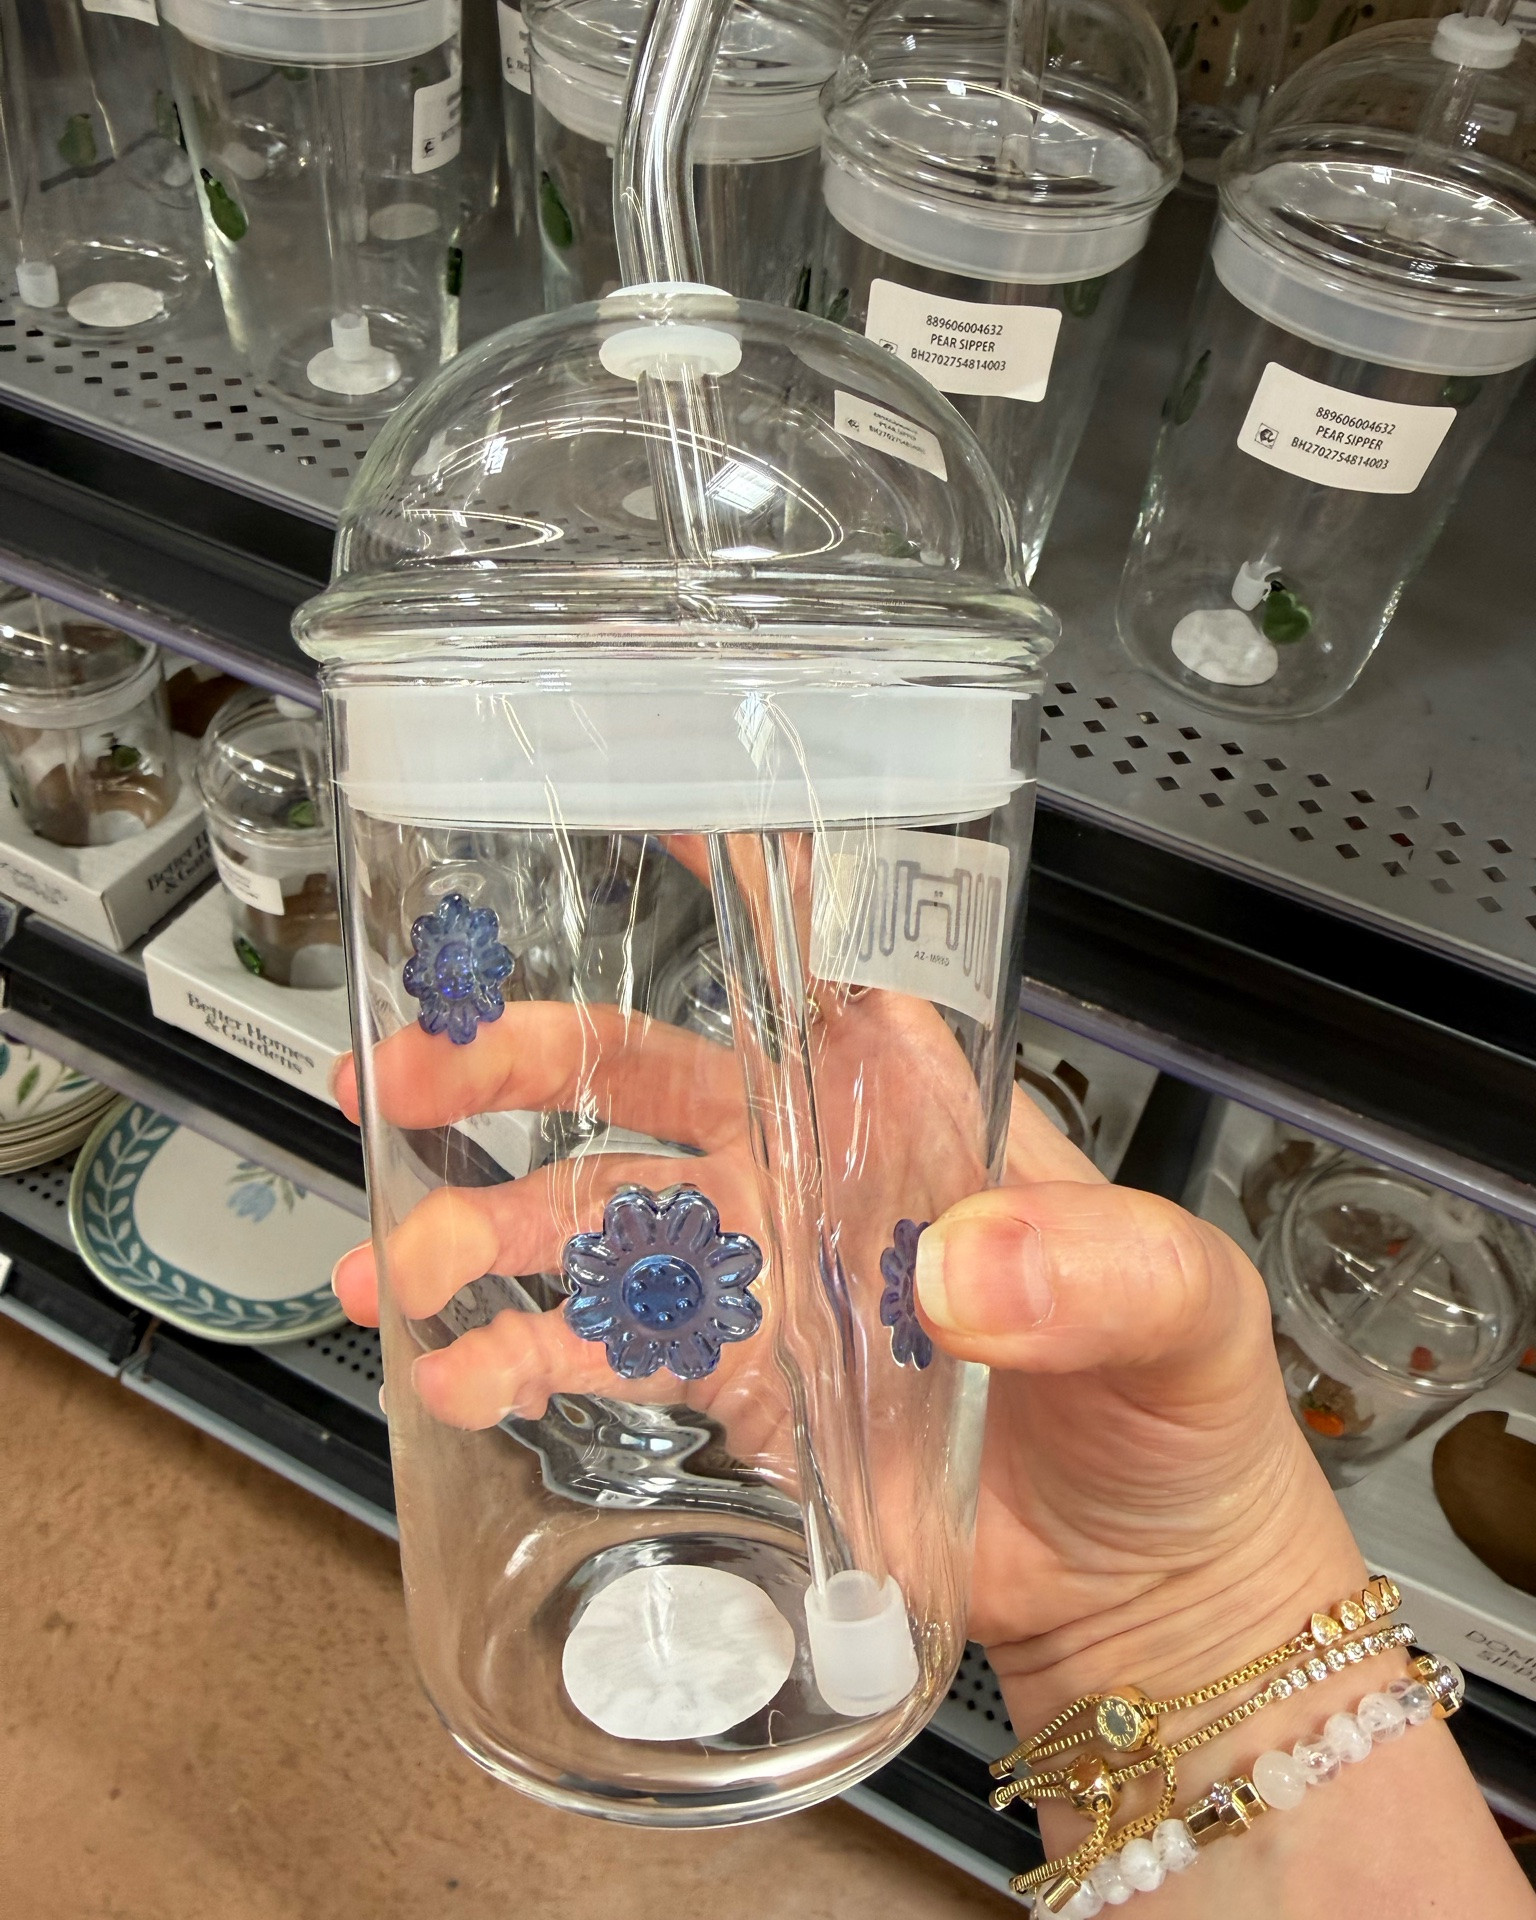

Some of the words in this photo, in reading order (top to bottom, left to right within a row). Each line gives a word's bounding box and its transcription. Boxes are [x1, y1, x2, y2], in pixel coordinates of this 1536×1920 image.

[926, 315, 1004, 336] 889606004632
[930, 333, 957, 350] PEAR
[959, 339, 996, 353] SIPPER
[911, 348, 1007, 371] BH2702754814003
[1315, 406, 1396, 435] 889606004632
[1315, 425, 1344, 443] PEAR
[1345, 433, 1384, 451] SIPPER
[1291, 436, 1390, 470] BH2702754814003
[187, 991, 242, 1030] Better
[247, 1023, 315, 1068] Homes
[1465, 1630, 1536, 1668] DOMI
